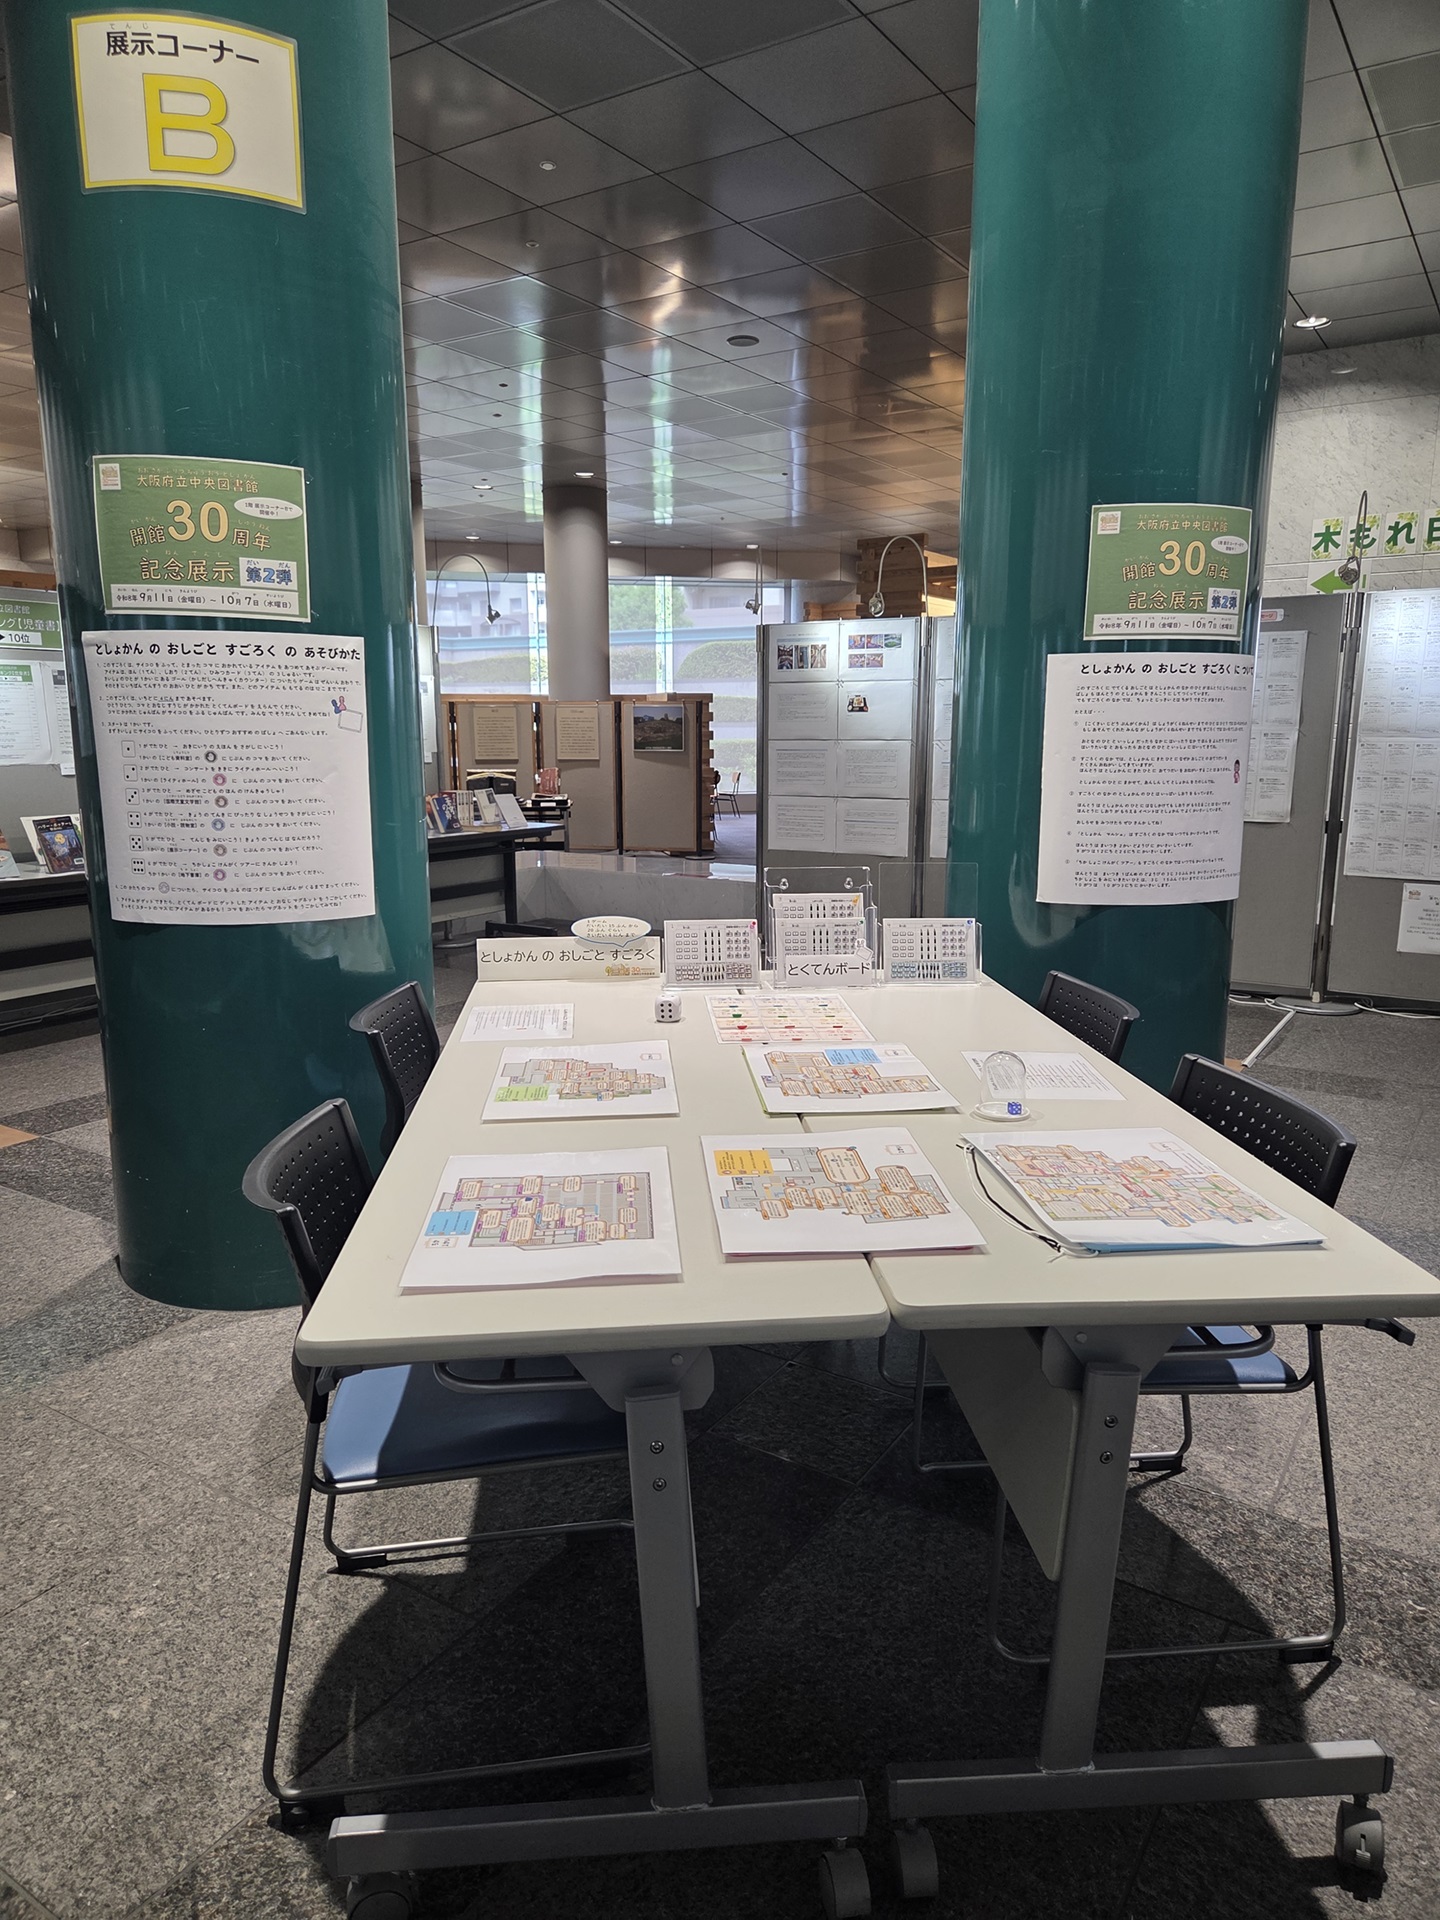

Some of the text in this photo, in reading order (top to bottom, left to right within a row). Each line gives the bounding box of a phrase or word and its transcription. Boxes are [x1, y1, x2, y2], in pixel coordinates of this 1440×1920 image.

[106, 31, 260, 64] 展示コーナー
[142, 72, 235, 176] B
[137, 474, 259, 493] 大阪府立中央図書館
[1136, 519, 1228, 533] 大阪府立中央図書館
[139, 557, 235, 583] 記念展示
[245, 566, 293, 586] 第2弾
[1128, 590, 1205, 610] 記念展示
[1211, 595, 1238, 611] 第2弾
[95, 643, 361, 660] としょかん の おしごと すごろく の あそびかた
[1081, 663, 1136, 674] としょかん
[1142, 663, 1152, 674] の
[1158, 662, 1197, 674] おしごと
[1202, 663, 1231, 674] すごろく
[480, 948, 656, 963] としょかん の おしごと すごろく
[788, 962, 871, 976] とくてんボード
